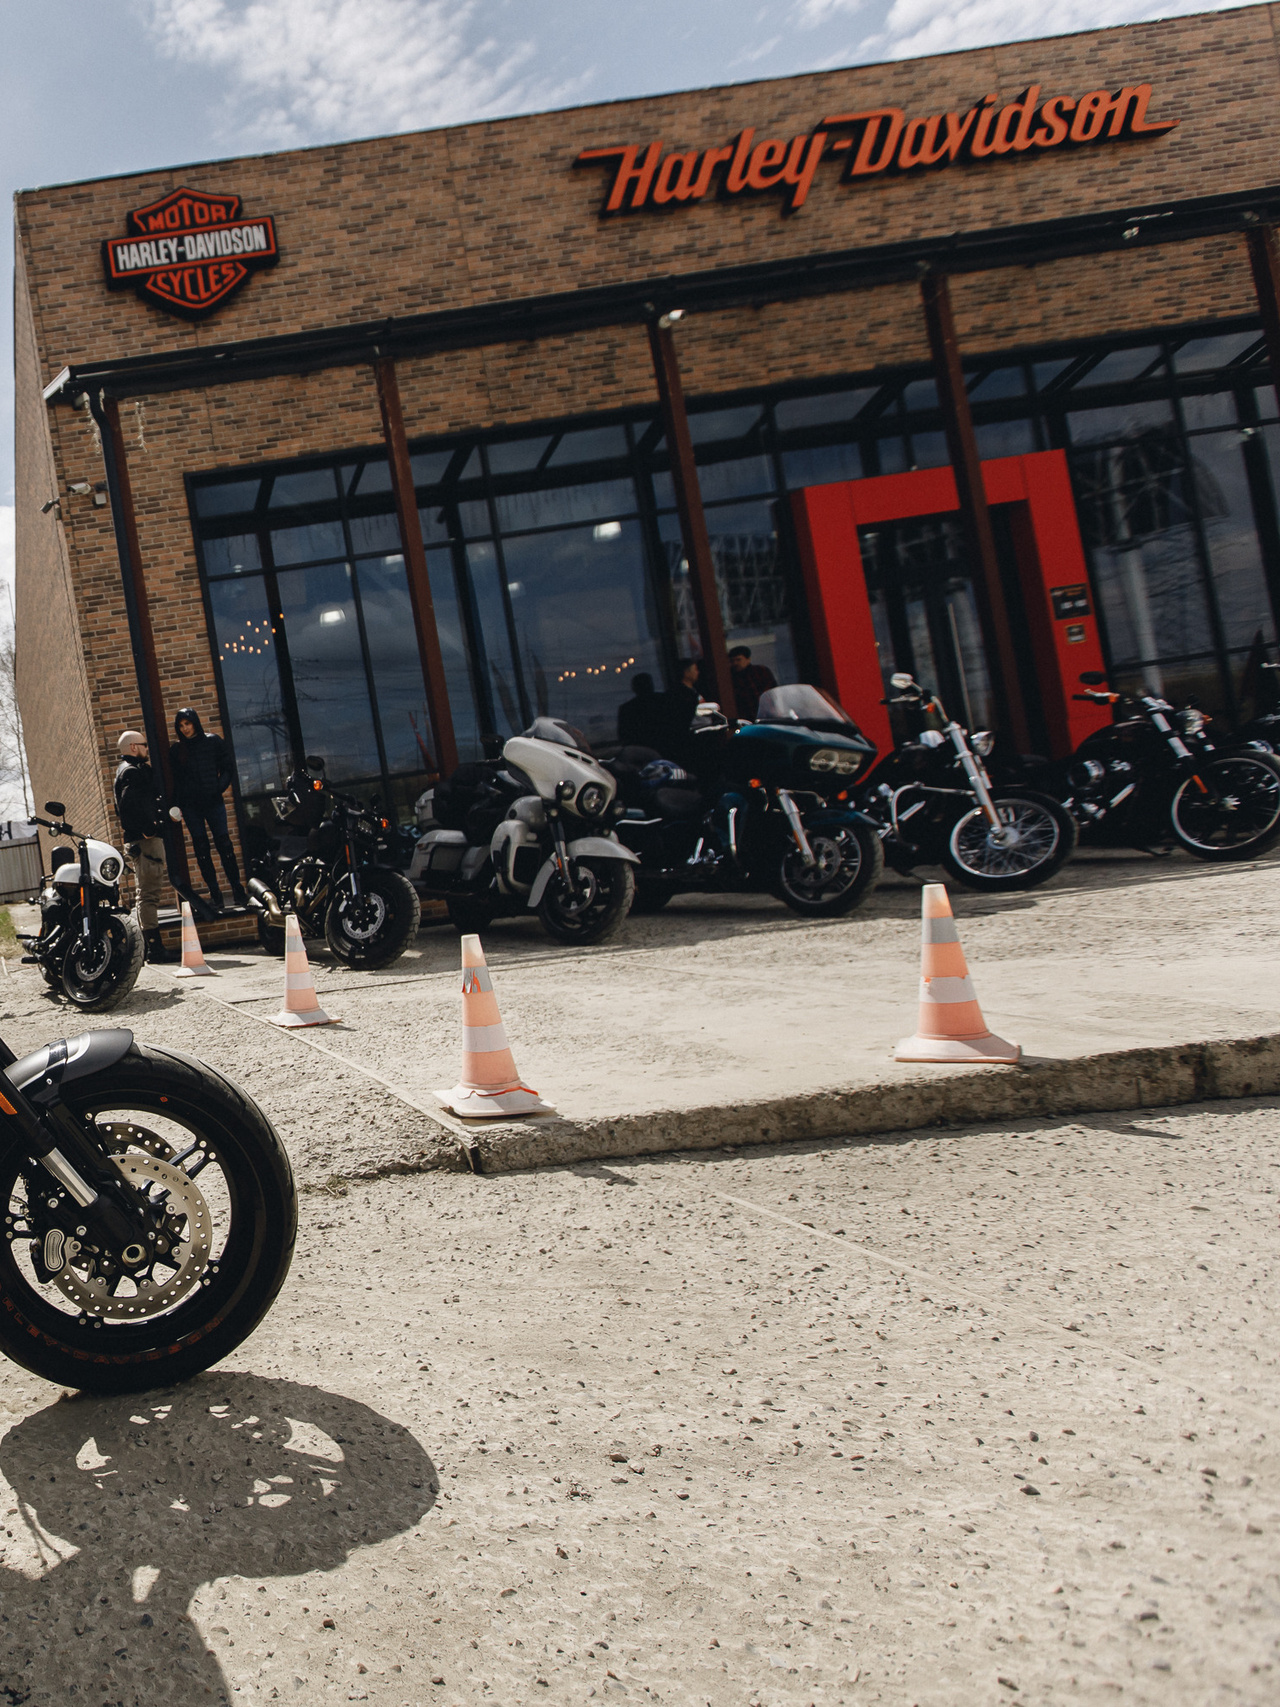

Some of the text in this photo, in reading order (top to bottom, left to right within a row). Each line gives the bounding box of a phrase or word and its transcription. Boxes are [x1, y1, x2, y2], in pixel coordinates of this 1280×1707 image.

[578, 82, 1181, 212] Harley-Davidson
[147, 197, 227, 231] MOTOR
[116, 224, 267, 271] HARLEY-DAVIDSON
[156, 262, 237, 300] CYCLES
